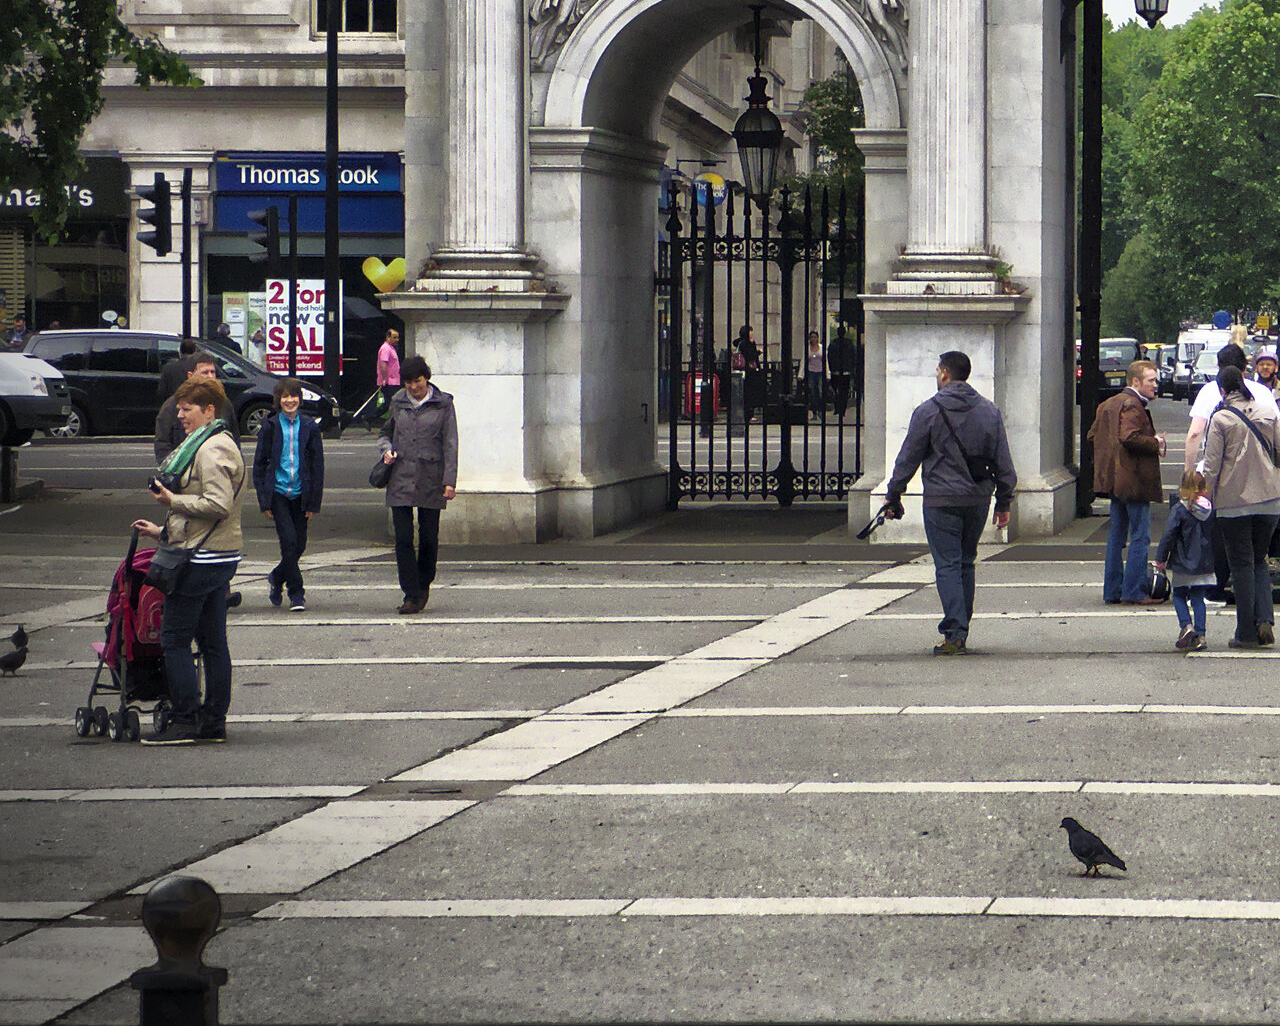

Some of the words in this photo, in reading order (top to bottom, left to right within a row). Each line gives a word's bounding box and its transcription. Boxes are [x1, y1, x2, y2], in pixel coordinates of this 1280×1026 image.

[236, 164, 320, 185] Thomas
[338, 164, 379, 185] ook
[269, 281, 284, 304] 2
[268, 327, 324, 351] SAL
[269, 361, 285, 369] This
